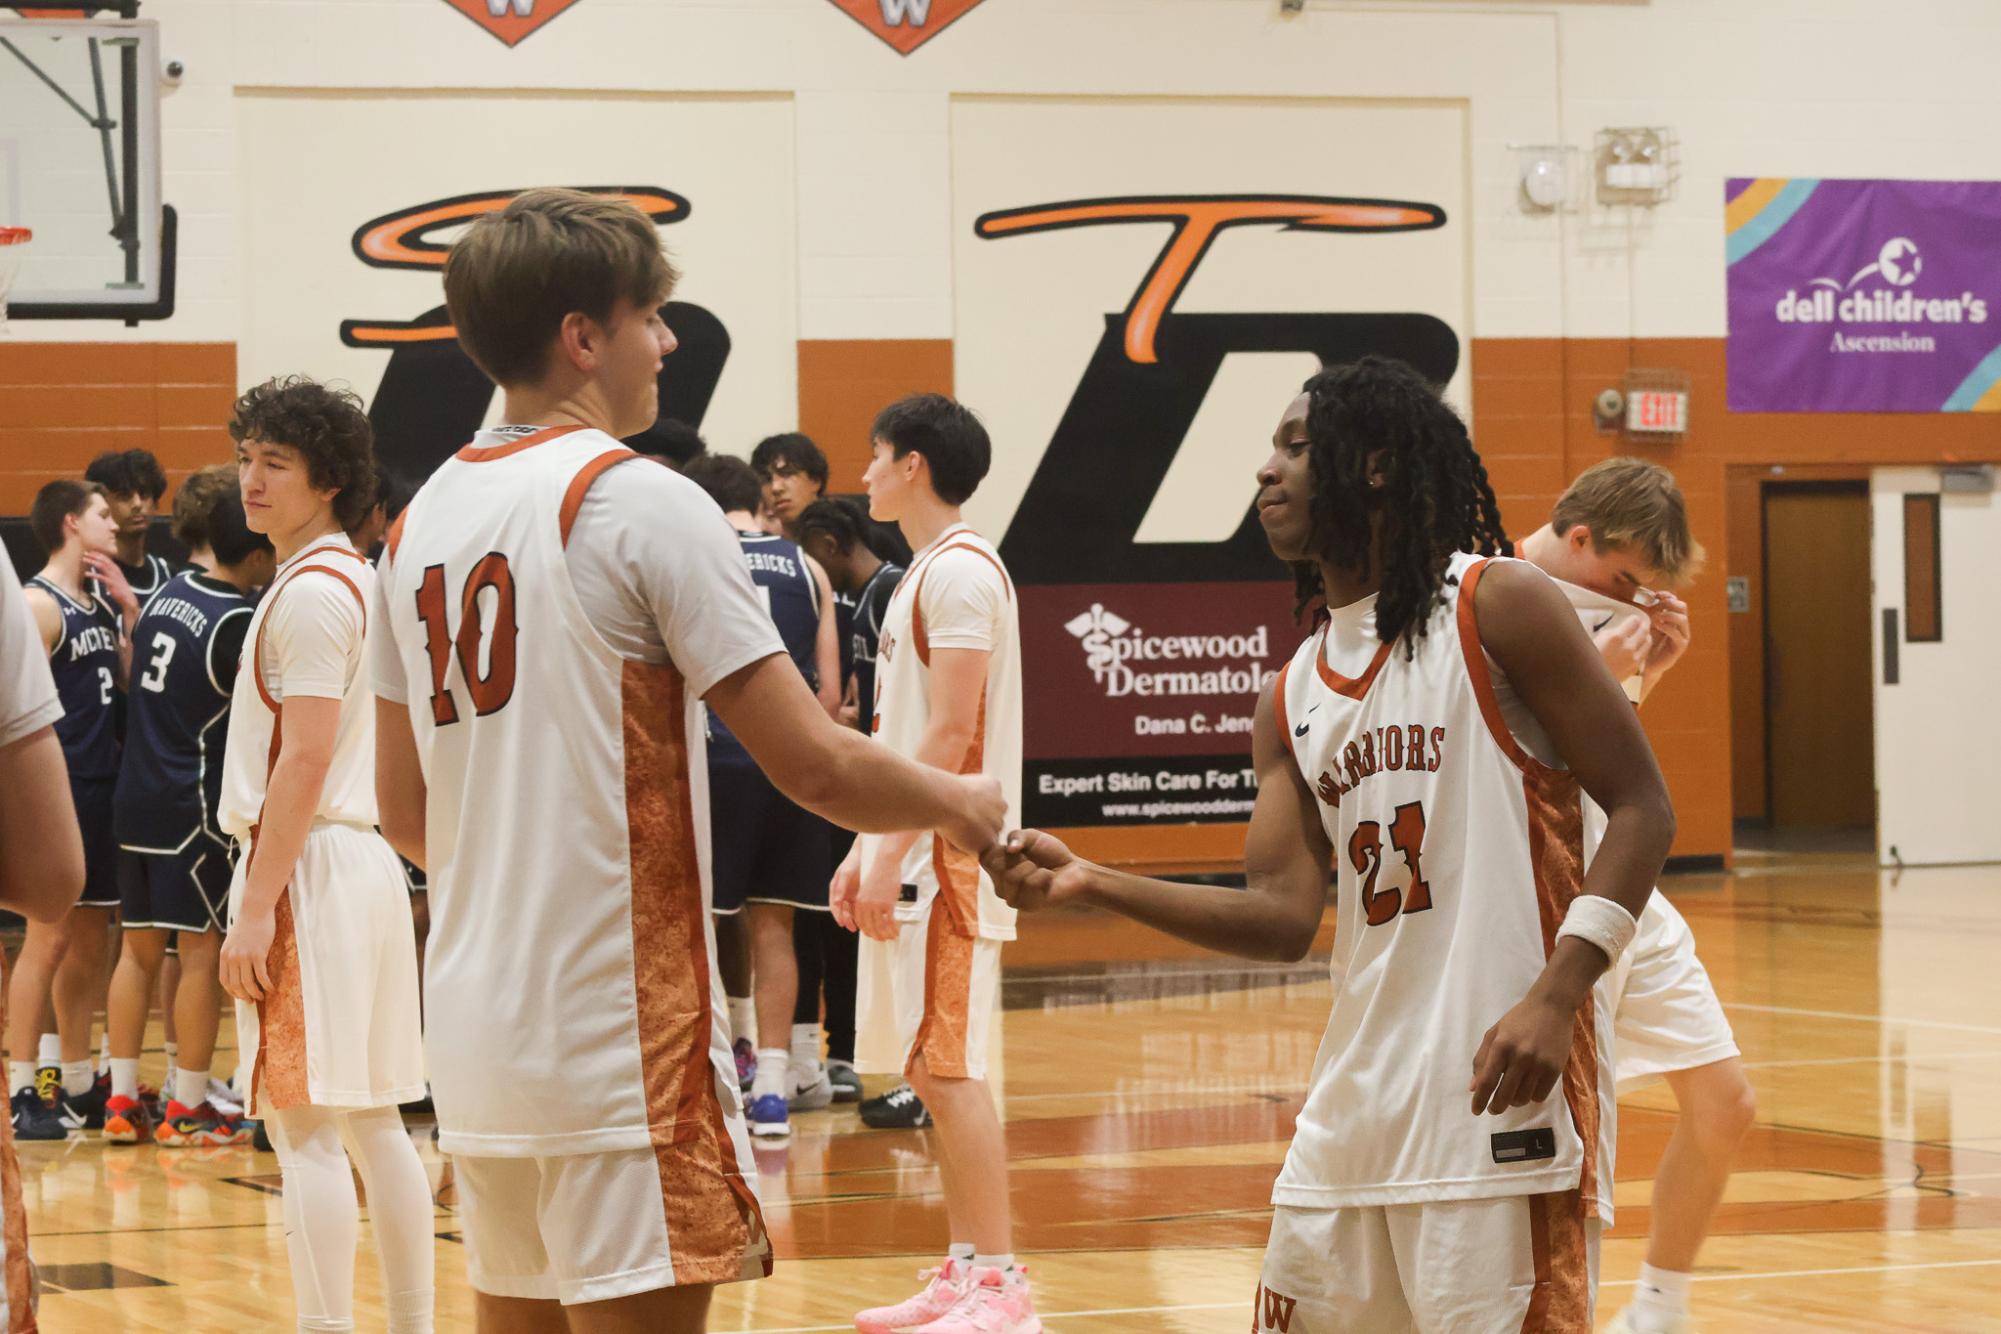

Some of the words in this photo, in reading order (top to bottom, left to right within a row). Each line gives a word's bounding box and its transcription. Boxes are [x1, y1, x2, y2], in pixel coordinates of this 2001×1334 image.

[1776, 289, 1834, 323] dell
[1838, 289, 1988, 323] children's
[1830, 331, 1936, 353] Ascension
[1640, 391, 1679, 427] EXIT
[149, 597, 208, 638] MAVERICKS
[415, 551, 519, 727] 10
[1082, 625, 1269, 672] Spicewood
[140, 631, 177, 693] 3
[97, 666, 114, 705] 2
[1135, 715, 1186, 735] Dana
[1190, 713, 1212, 734] C.
[1215, 713, 1254, 735] Jen
[1039, 773, 1103, 797] Expert
[1108, 772, 1151, 792] Skin
[1155, 771, 1202, 791] Care
[1205, 769, 1239, 789] For
[1348, 800, 1433, 927] 21
[1264, 1286, 1297, 1334] W
